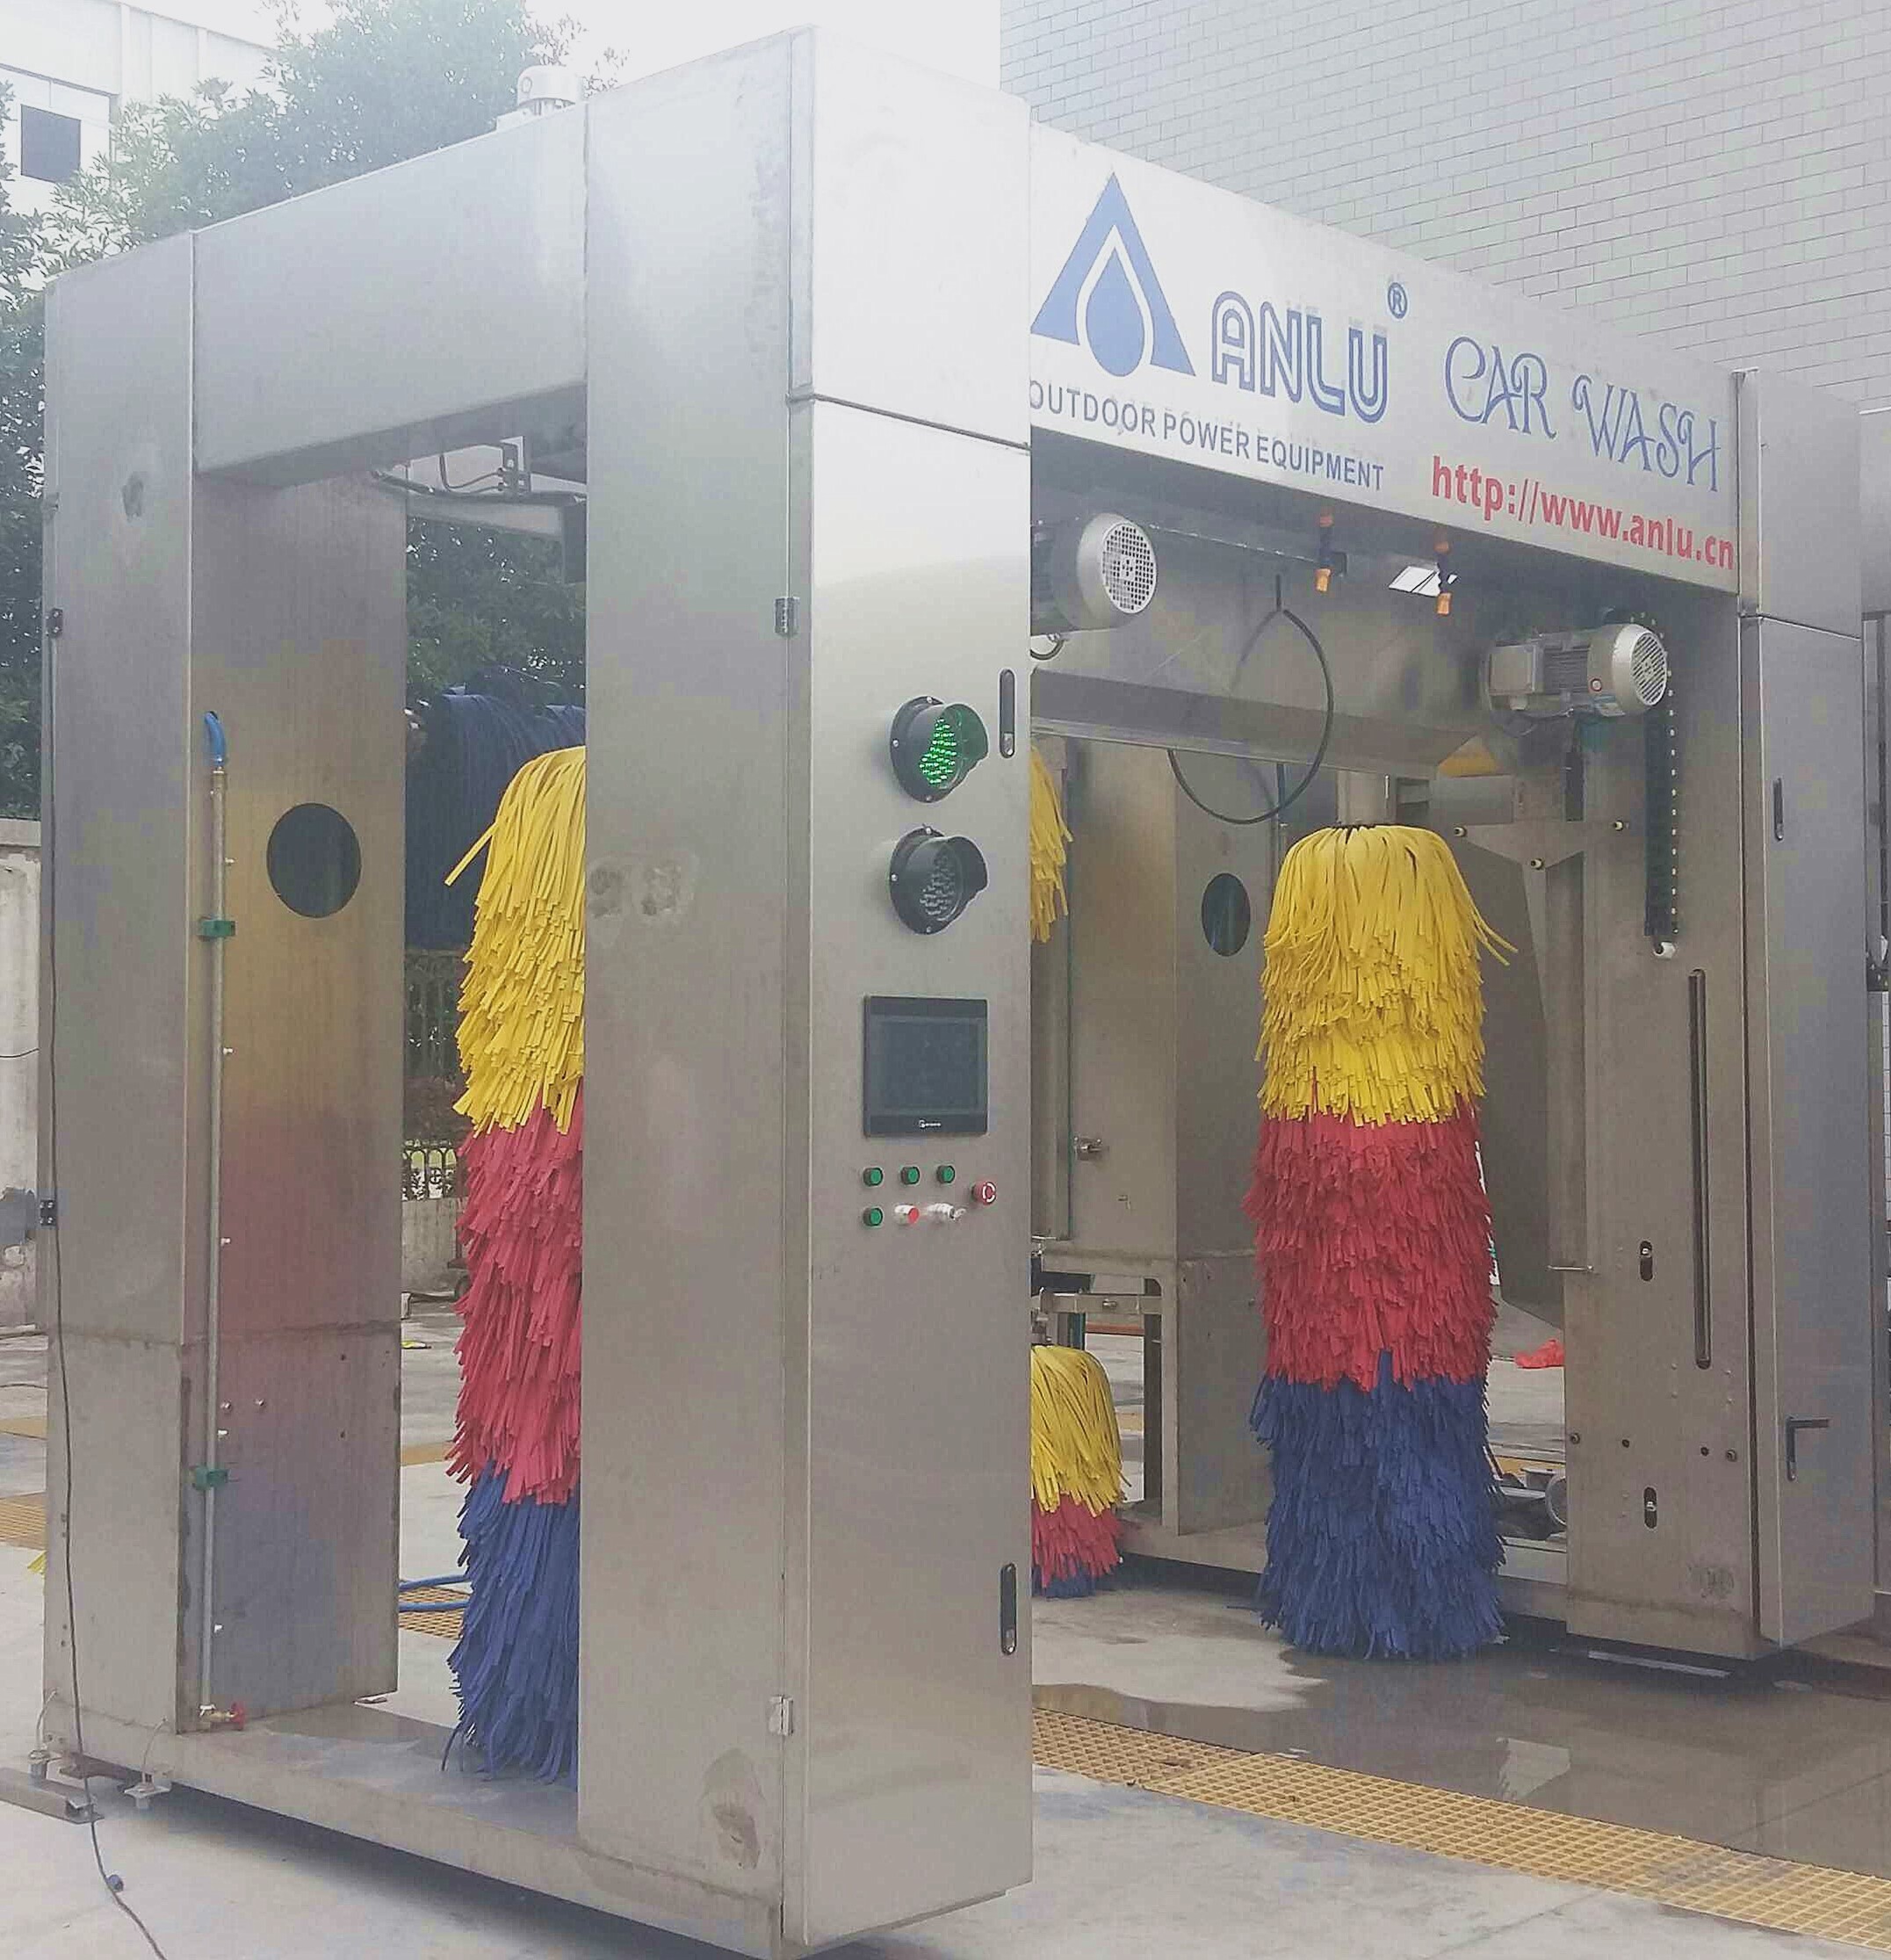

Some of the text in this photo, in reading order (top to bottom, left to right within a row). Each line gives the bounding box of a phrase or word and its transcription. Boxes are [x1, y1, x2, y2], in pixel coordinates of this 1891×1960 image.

[1212, 291, 1388, 423] ANLU
[1445, 336, 1721, 492] CAR WASH
[1029, 379, 1384, 491] OUTDOOR POWER EQUIPMENT
[1432, 455, 1735, 570] http://www.anlu.cn
